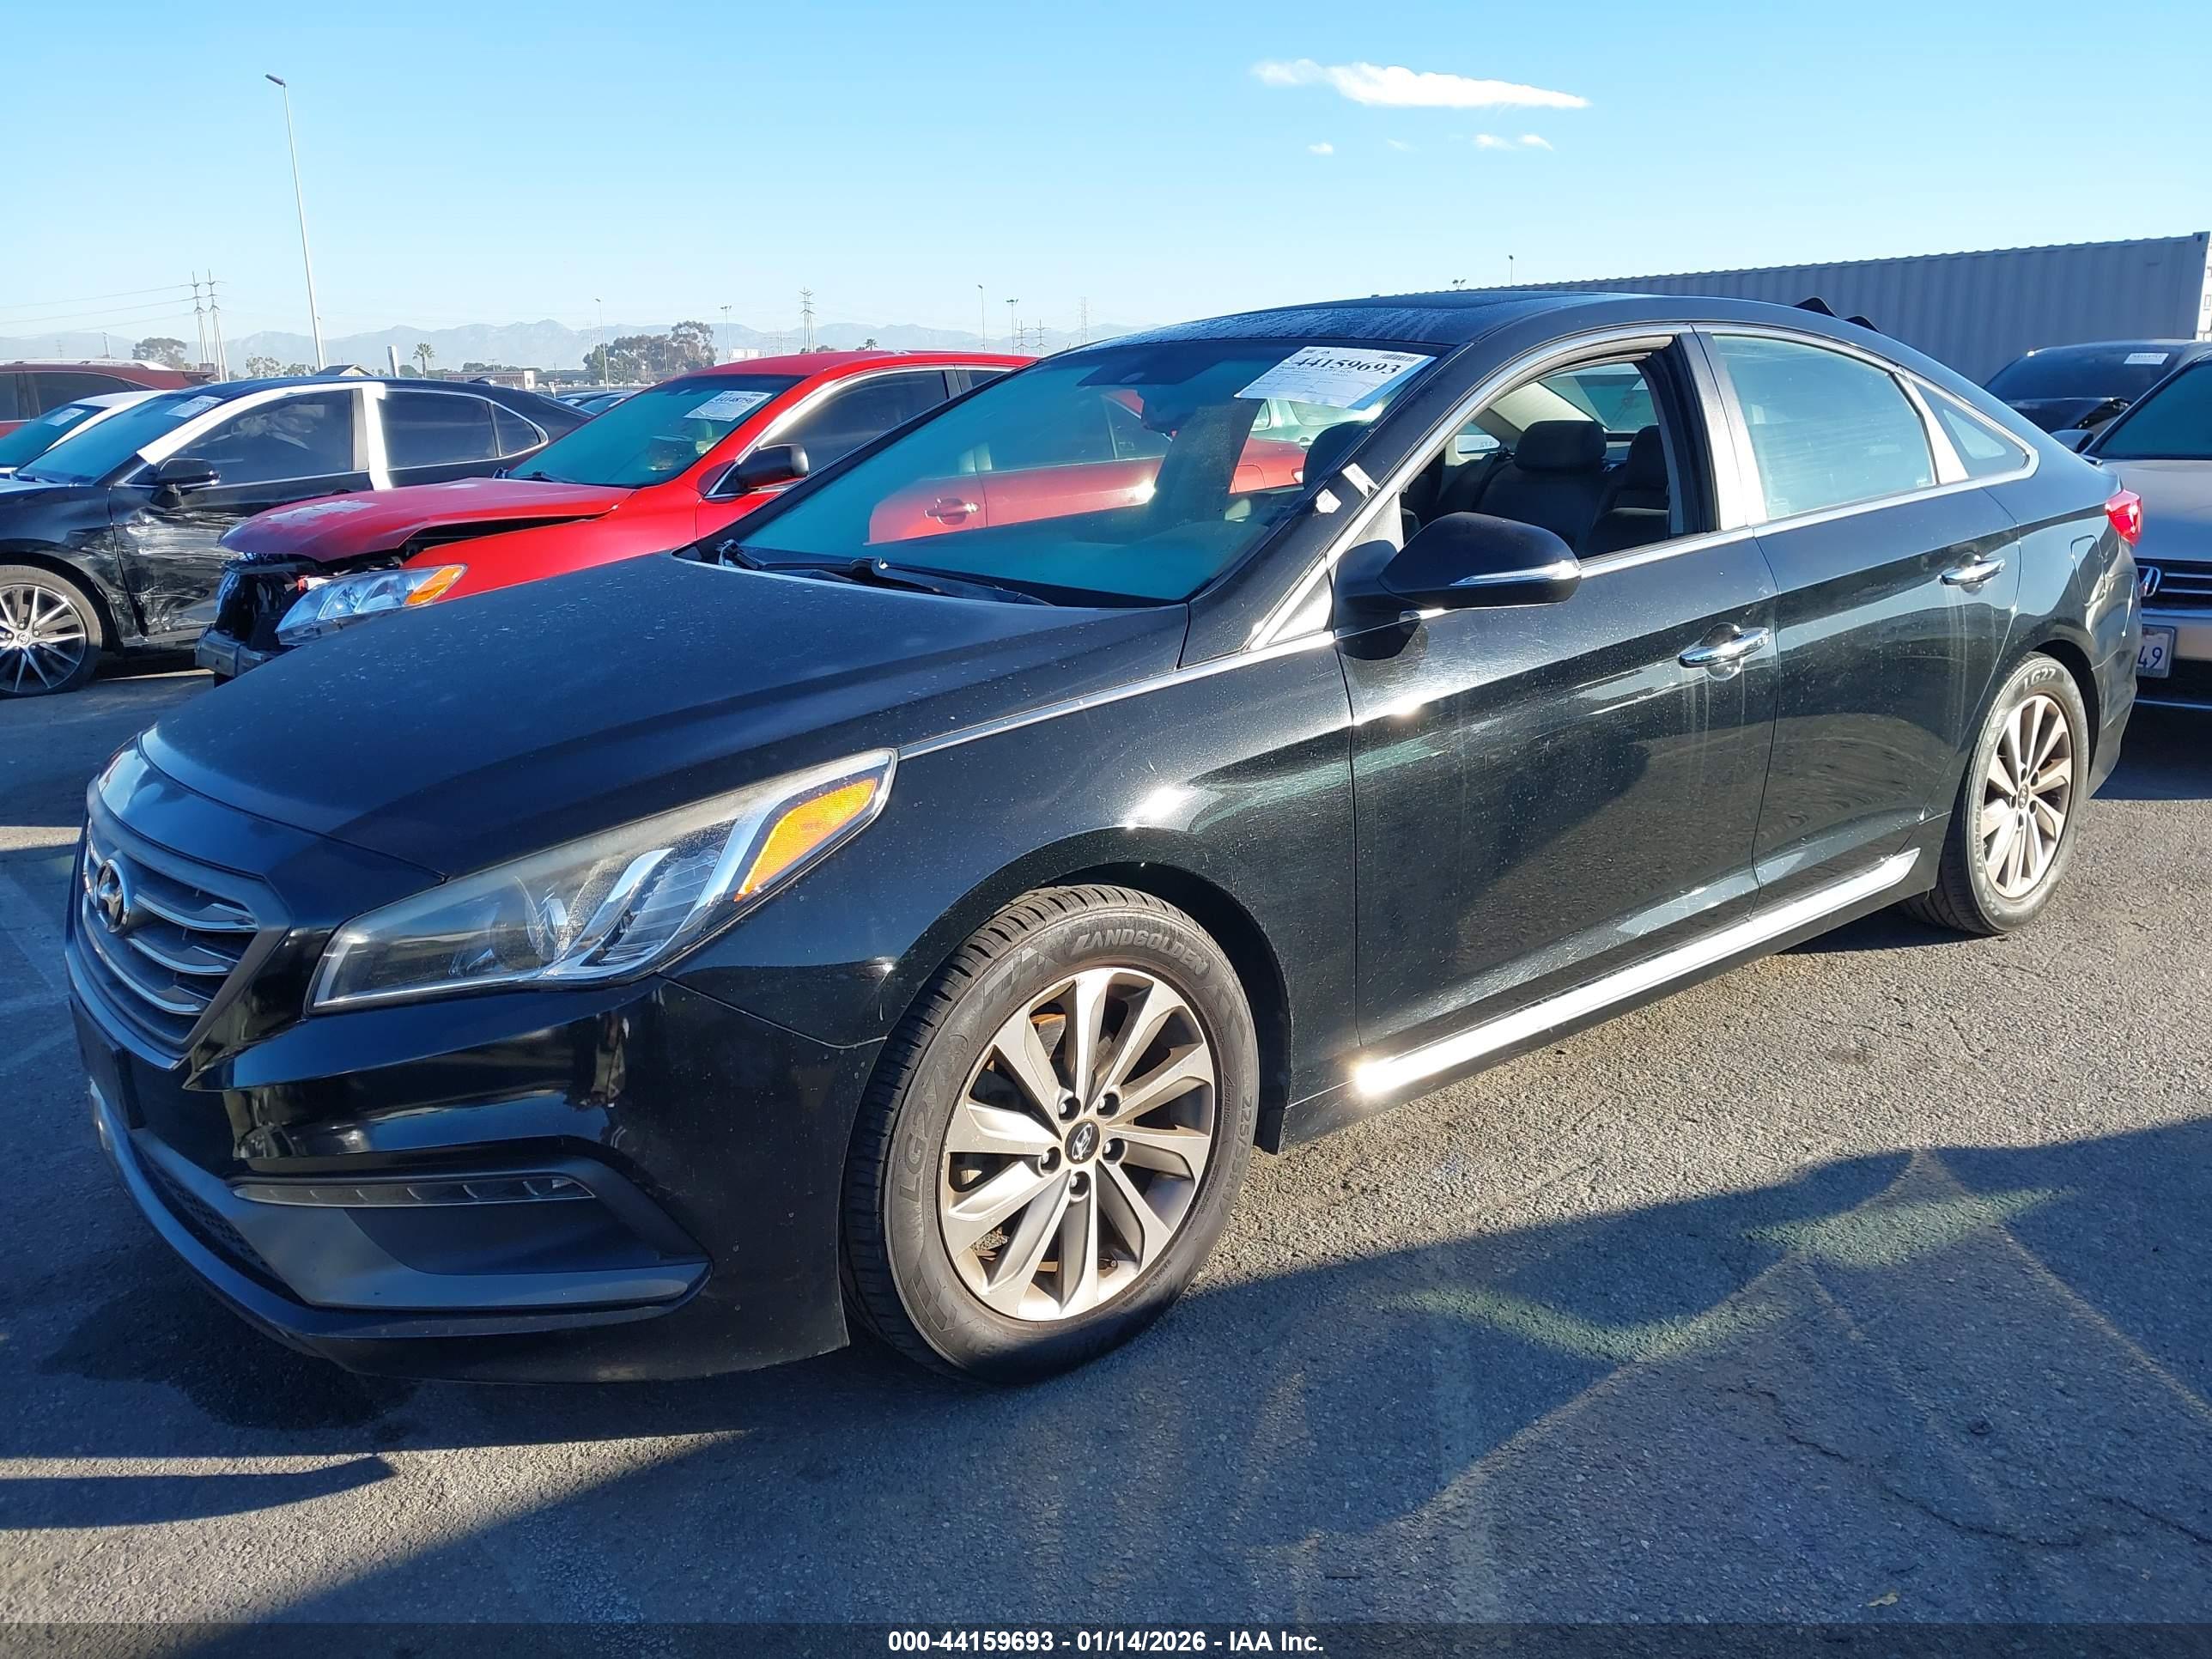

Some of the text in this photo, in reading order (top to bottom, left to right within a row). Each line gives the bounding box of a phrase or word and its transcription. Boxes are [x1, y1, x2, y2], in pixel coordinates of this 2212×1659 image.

[1291, 356, 1402, 375] 44159693
[2137, 645, 2163, 668] 49
[2024, 666, 2057, 692] LG27
[1071, 927, 1209, 975] LANDGOLDEN
